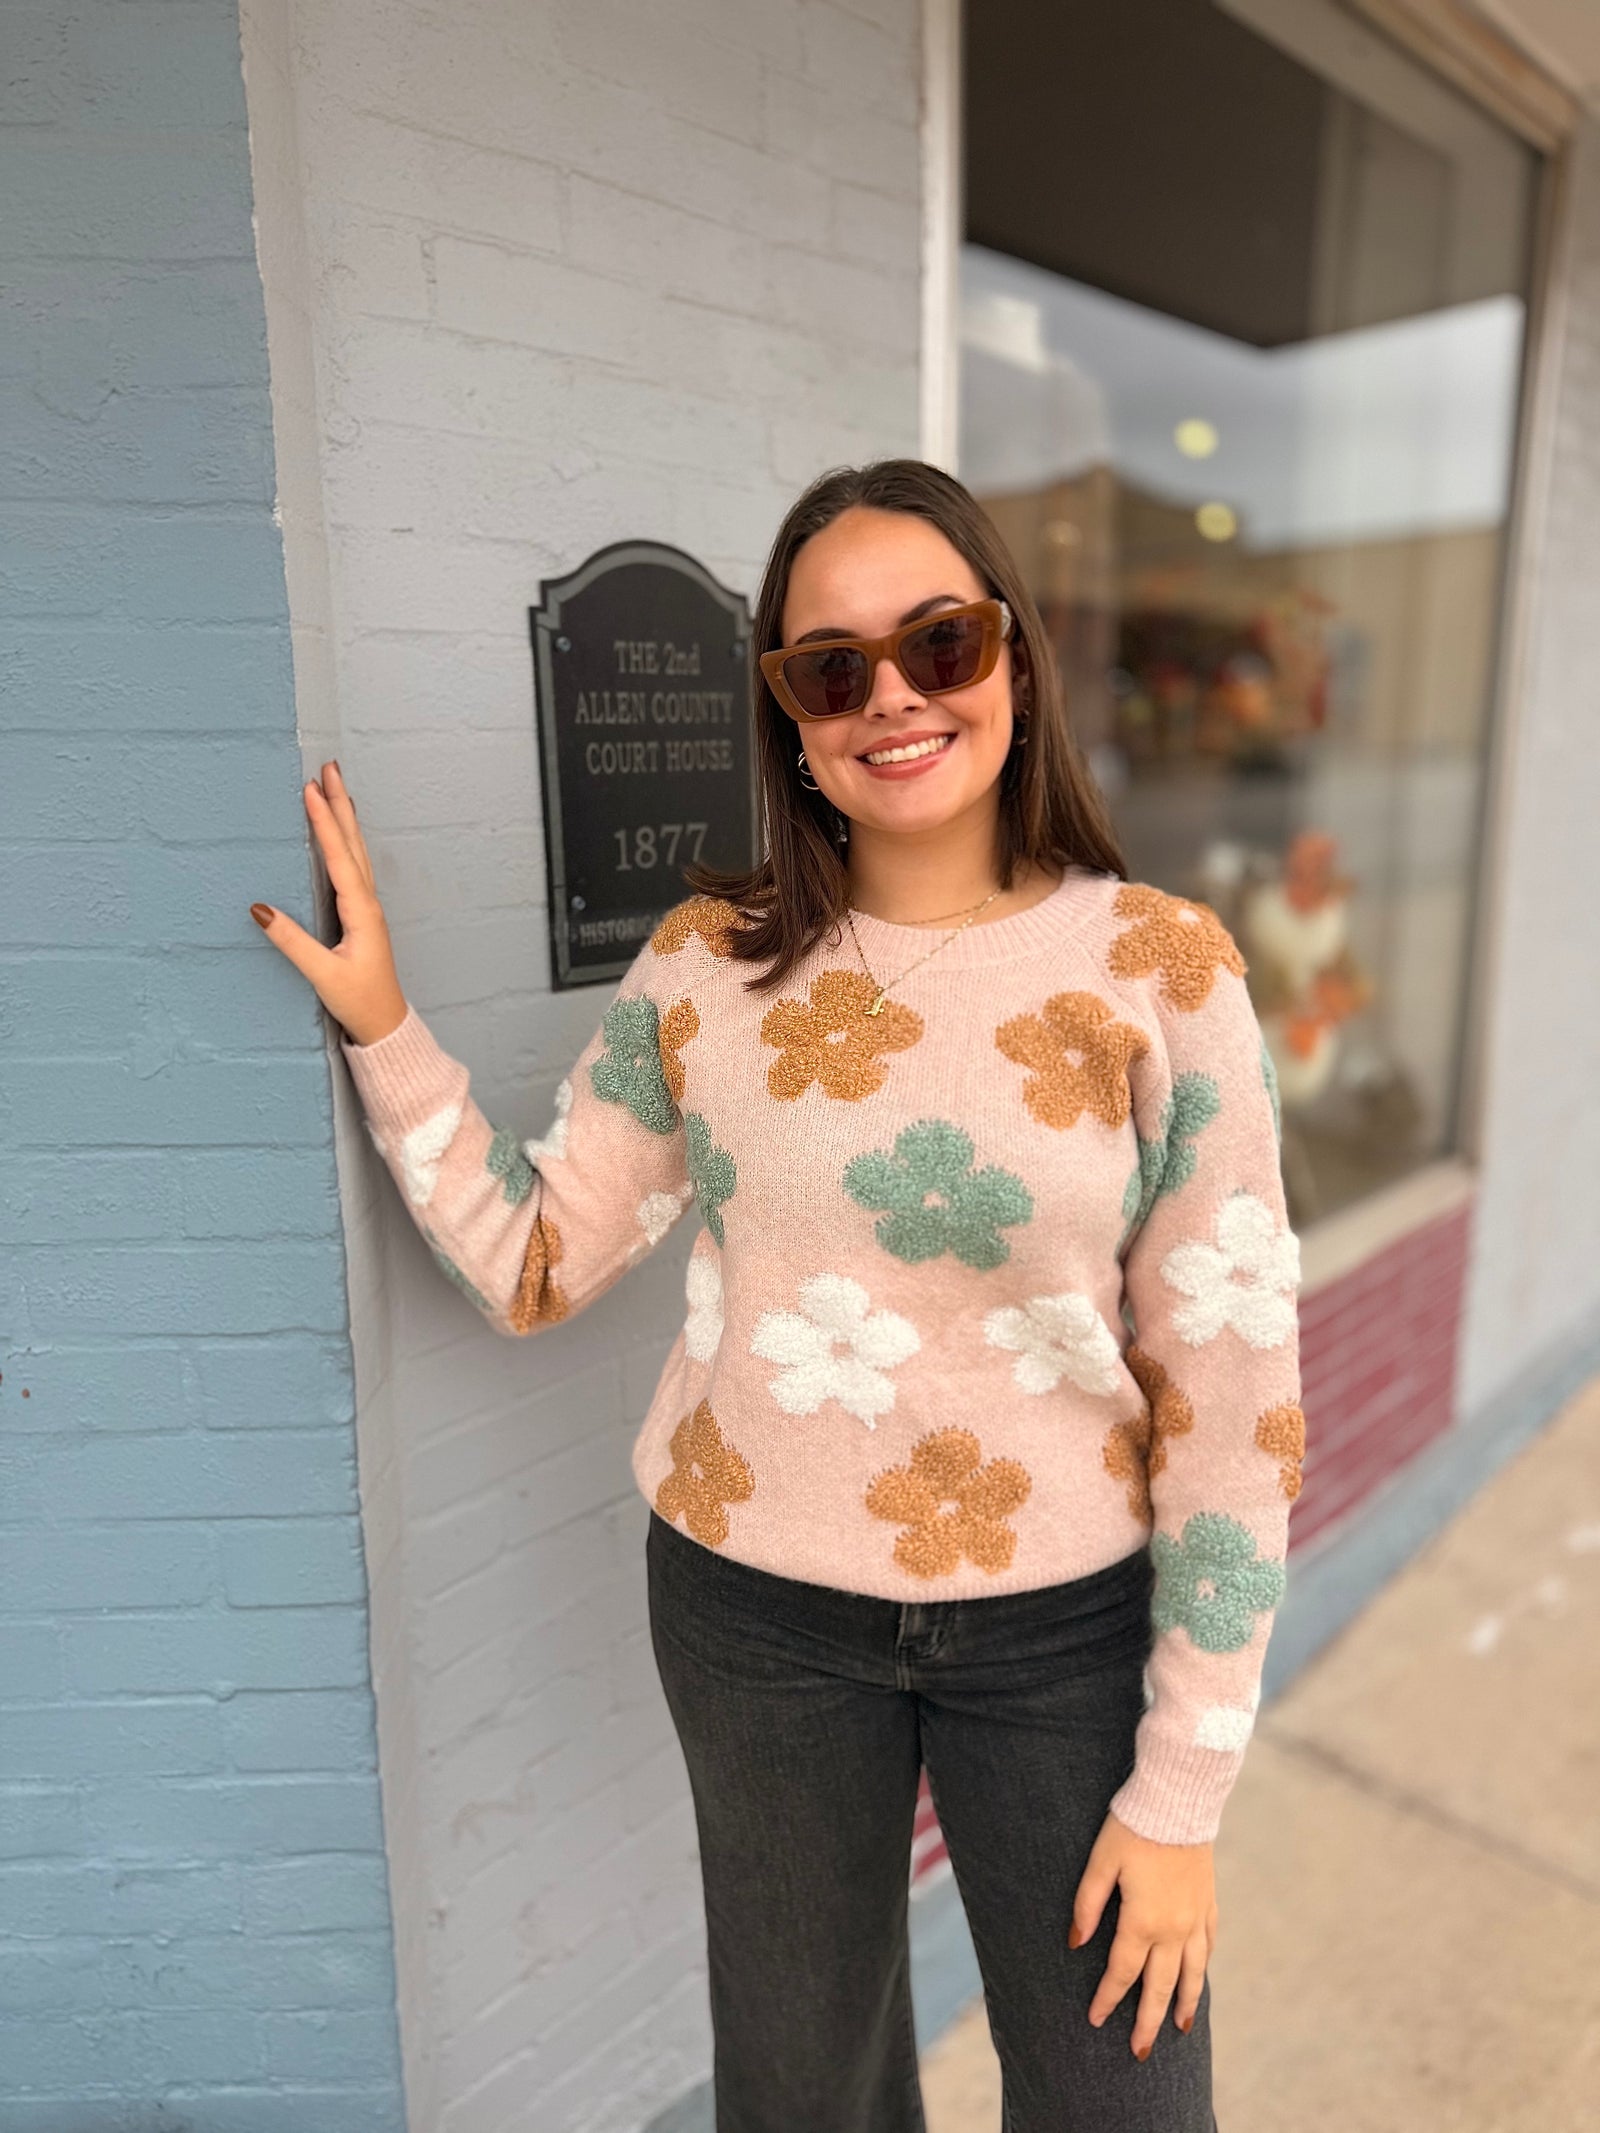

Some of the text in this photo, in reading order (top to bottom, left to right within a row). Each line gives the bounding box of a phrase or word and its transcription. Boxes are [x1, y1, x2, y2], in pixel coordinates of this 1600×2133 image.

[613, 640, 701, 675] THE 2nd
[575, 691, 734, 724] ALLEN COUNTY
[586, 739, 734, 774] COURT HOUSE
[614, 822, 708, 871] 1877
